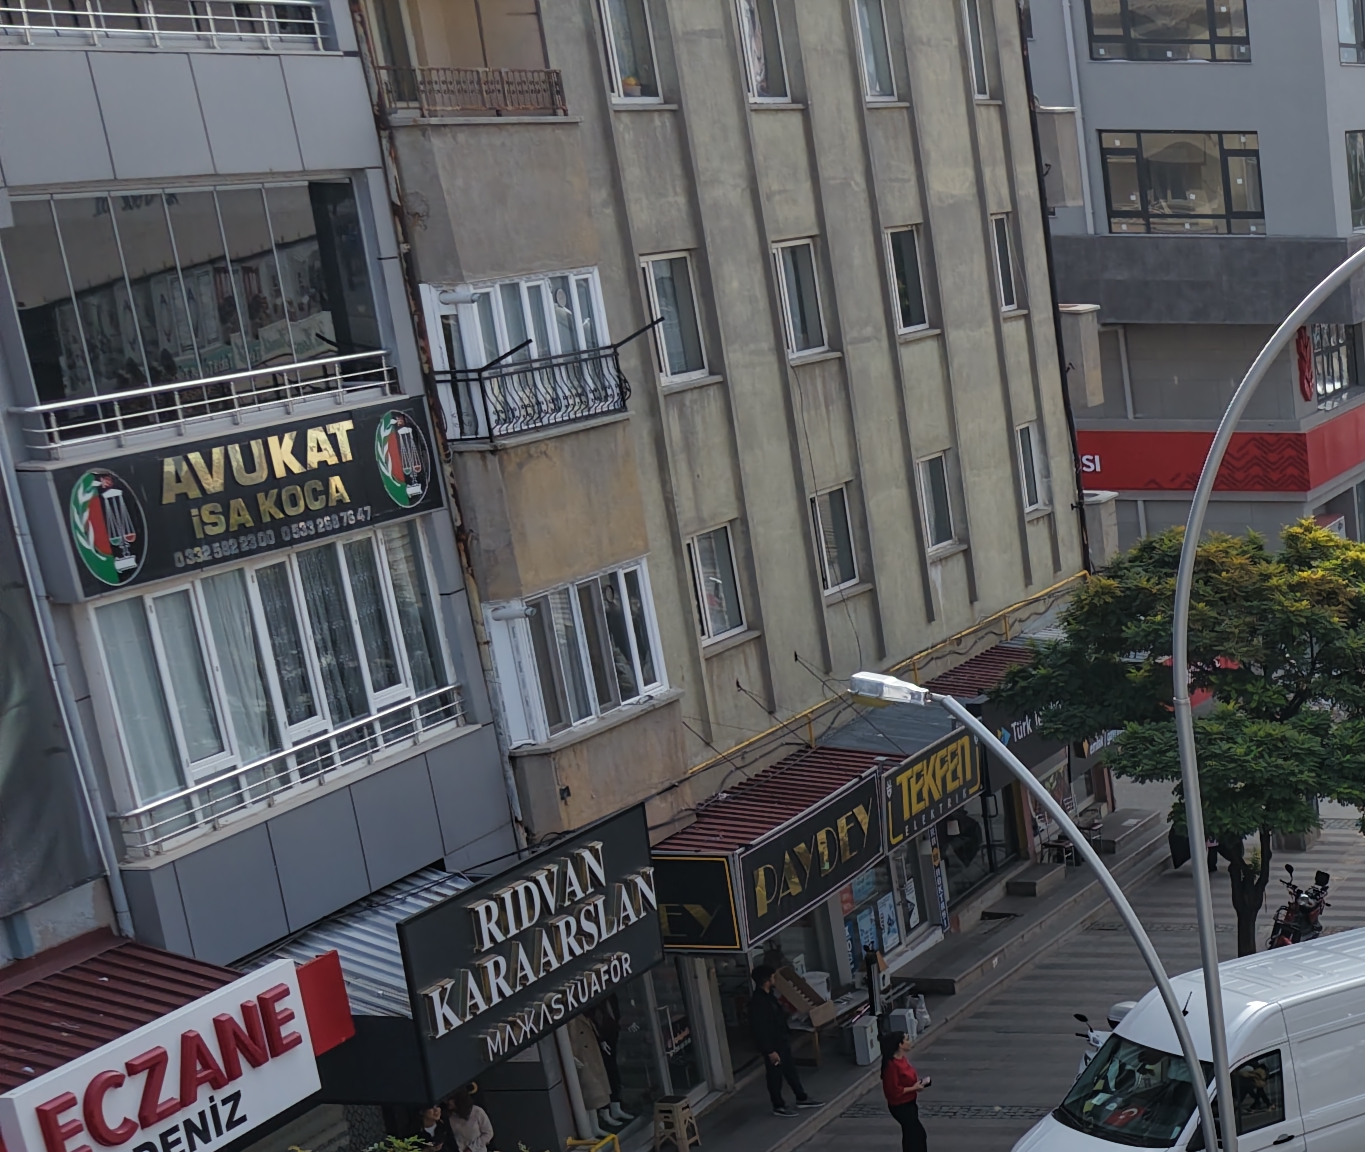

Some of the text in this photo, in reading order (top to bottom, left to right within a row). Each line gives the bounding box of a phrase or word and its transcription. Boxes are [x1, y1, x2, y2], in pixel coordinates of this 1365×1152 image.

[162, 420, 354, 504] AVUKAT
[256, 475, 351, 523] KOCA
[896, 735, 972, 821] TEKFEN
[472, 841, 607, 952] RIDVAN
[754, 798, 873, 918] PAYDEY
[427, 866, 658, 1039] KARAARSLAN
